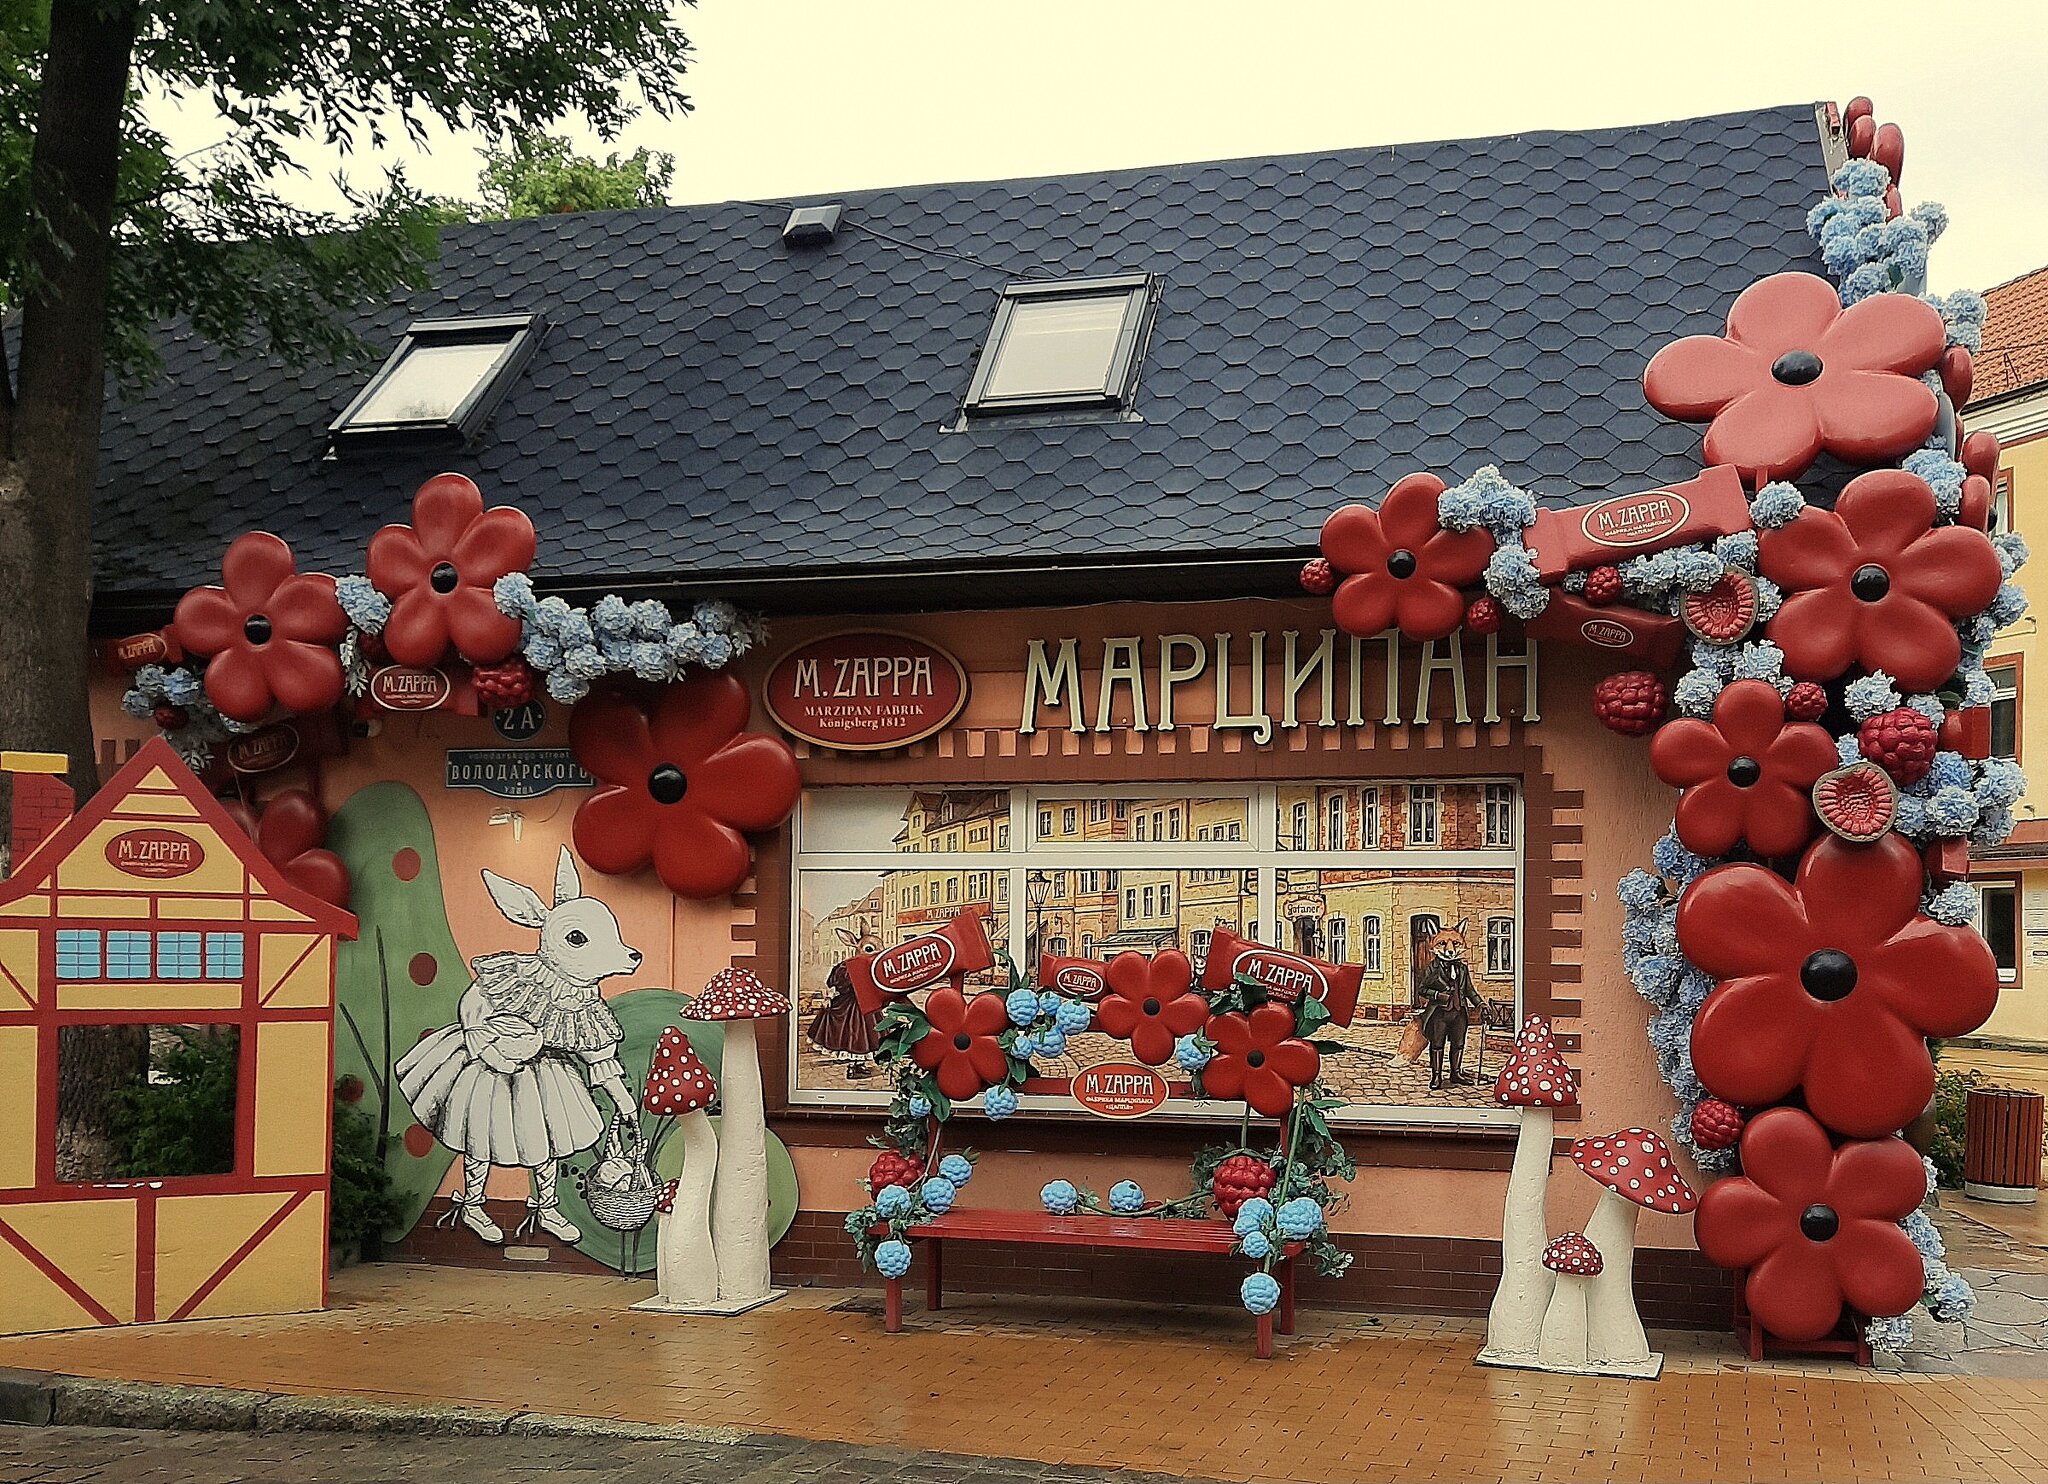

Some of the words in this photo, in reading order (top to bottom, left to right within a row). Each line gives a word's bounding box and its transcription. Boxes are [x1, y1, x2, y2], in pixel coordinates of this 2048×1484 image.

[832, 656, 934, 698] ZAPPA
[1019, 627, 1541, 744] МАРЦИПАН
[804, 705, 872, 716] MARZIPAN
[876, 704, 924, 715] FABRIK
[819, 717, 879, 731] Königsberg
[881, 717, 906, 727] 1812
[451, 763, 588, 781] ВОЛОДАРСКОГО
[1104, 1074, 1154, 1095] ZAPPA
